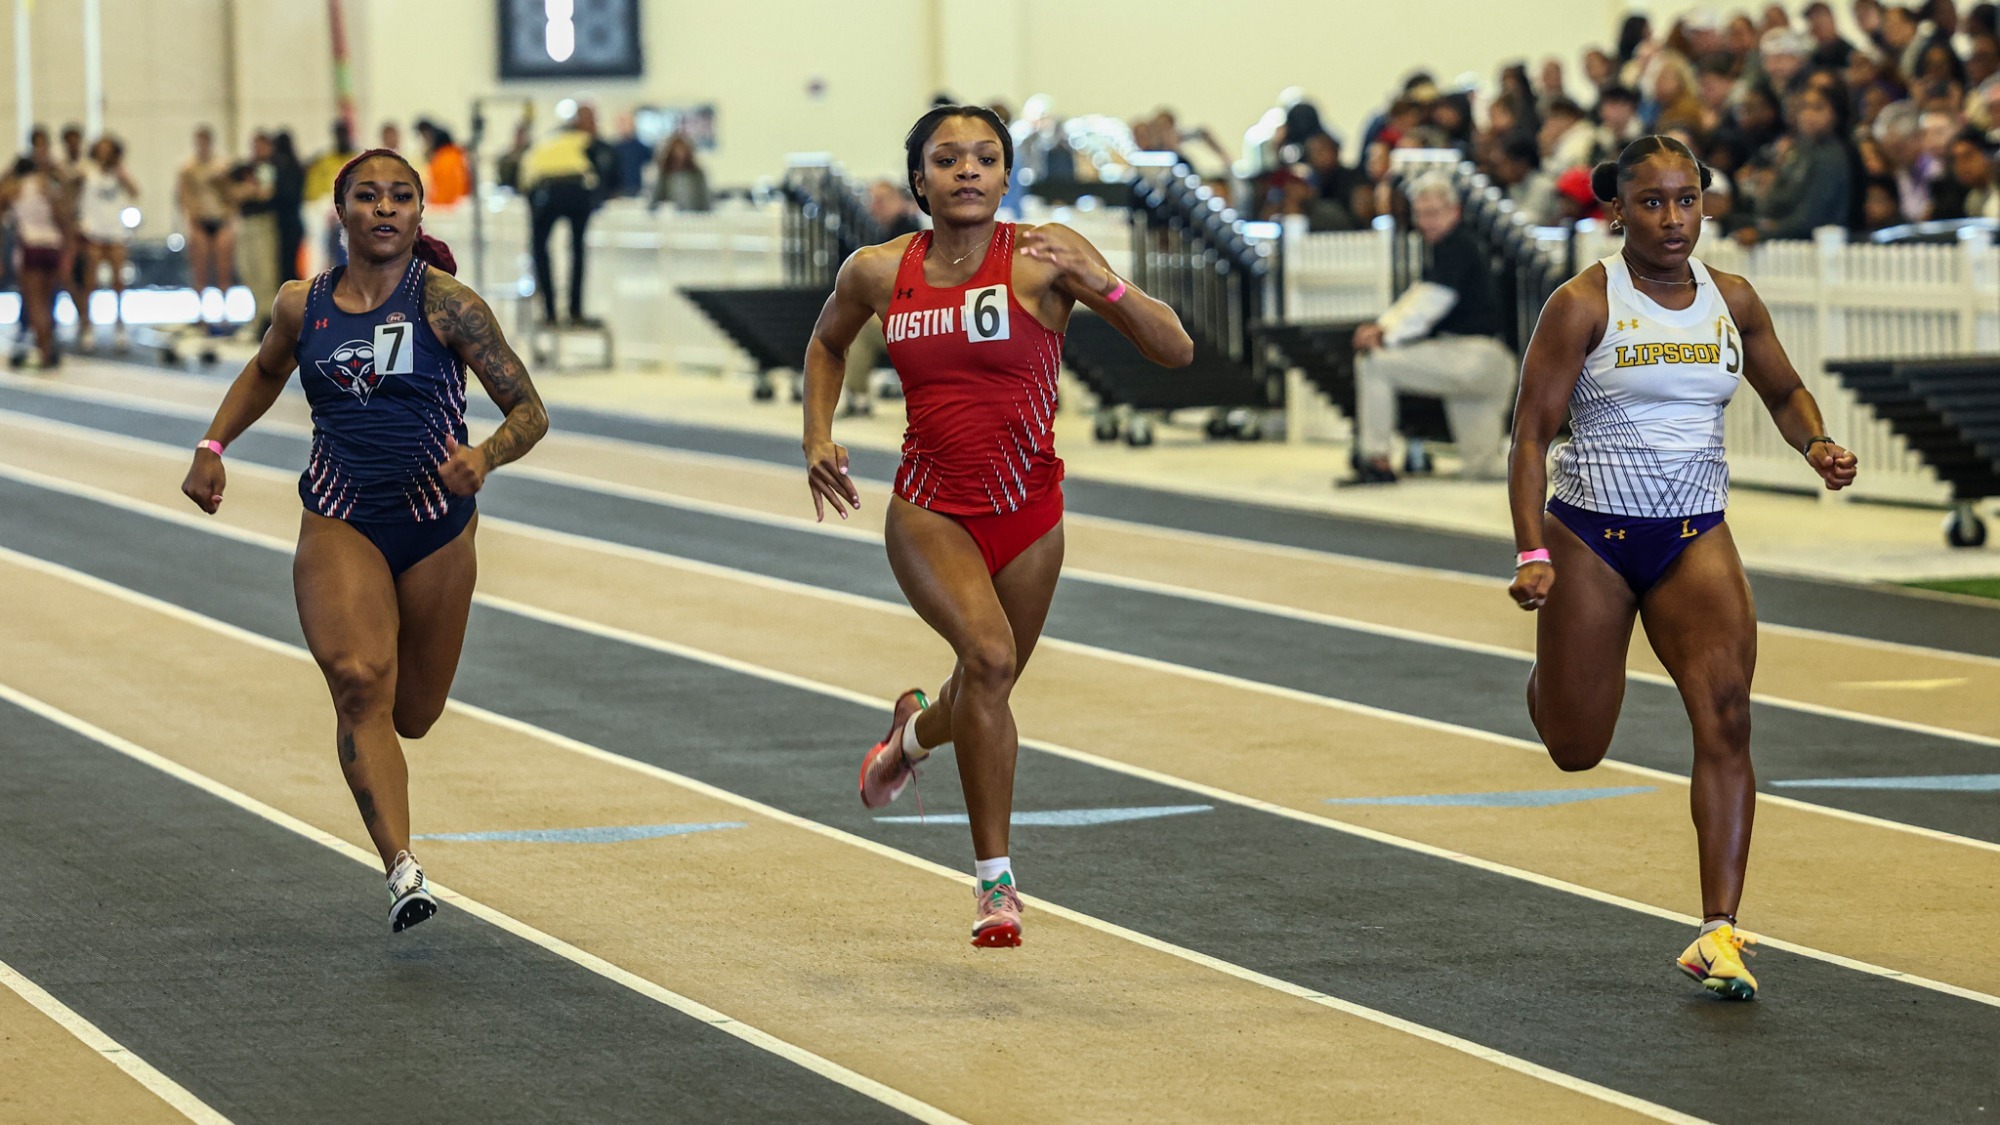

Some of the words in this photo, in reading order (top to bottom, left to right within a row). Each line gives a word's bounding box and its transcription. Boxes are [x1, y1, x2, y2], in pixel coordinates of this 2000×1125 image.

[886, 308, 954, 344] AUSTIN
[974, 288, 1000, 338] 6
[383, 325, 404, 371] 7
[1725, 323, 1740, 373] 5
[1680, 519, 1698, 538] L
